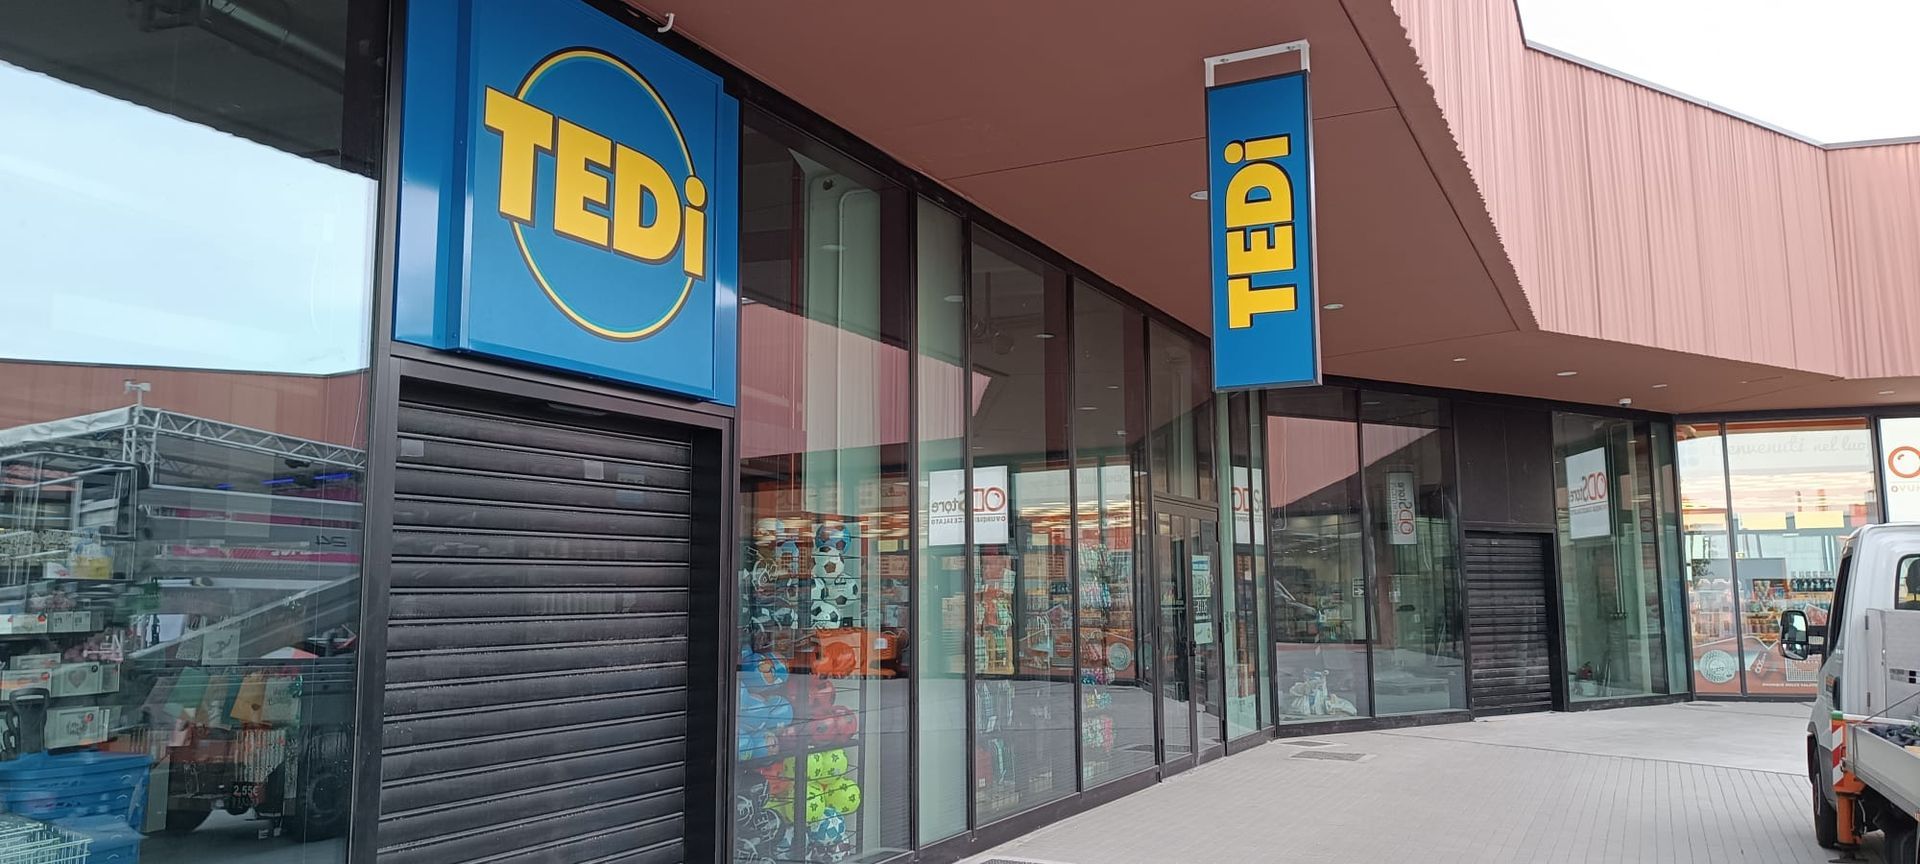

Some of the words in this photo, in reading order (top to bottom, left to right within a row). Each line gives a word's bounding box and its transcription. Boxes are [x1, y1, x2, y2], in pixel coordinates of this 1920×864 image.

[484, 85, 707, 281] TEDi
[1224, 132, 1299, 330] TEDi
[1813, 437, 1840, 453] nel
